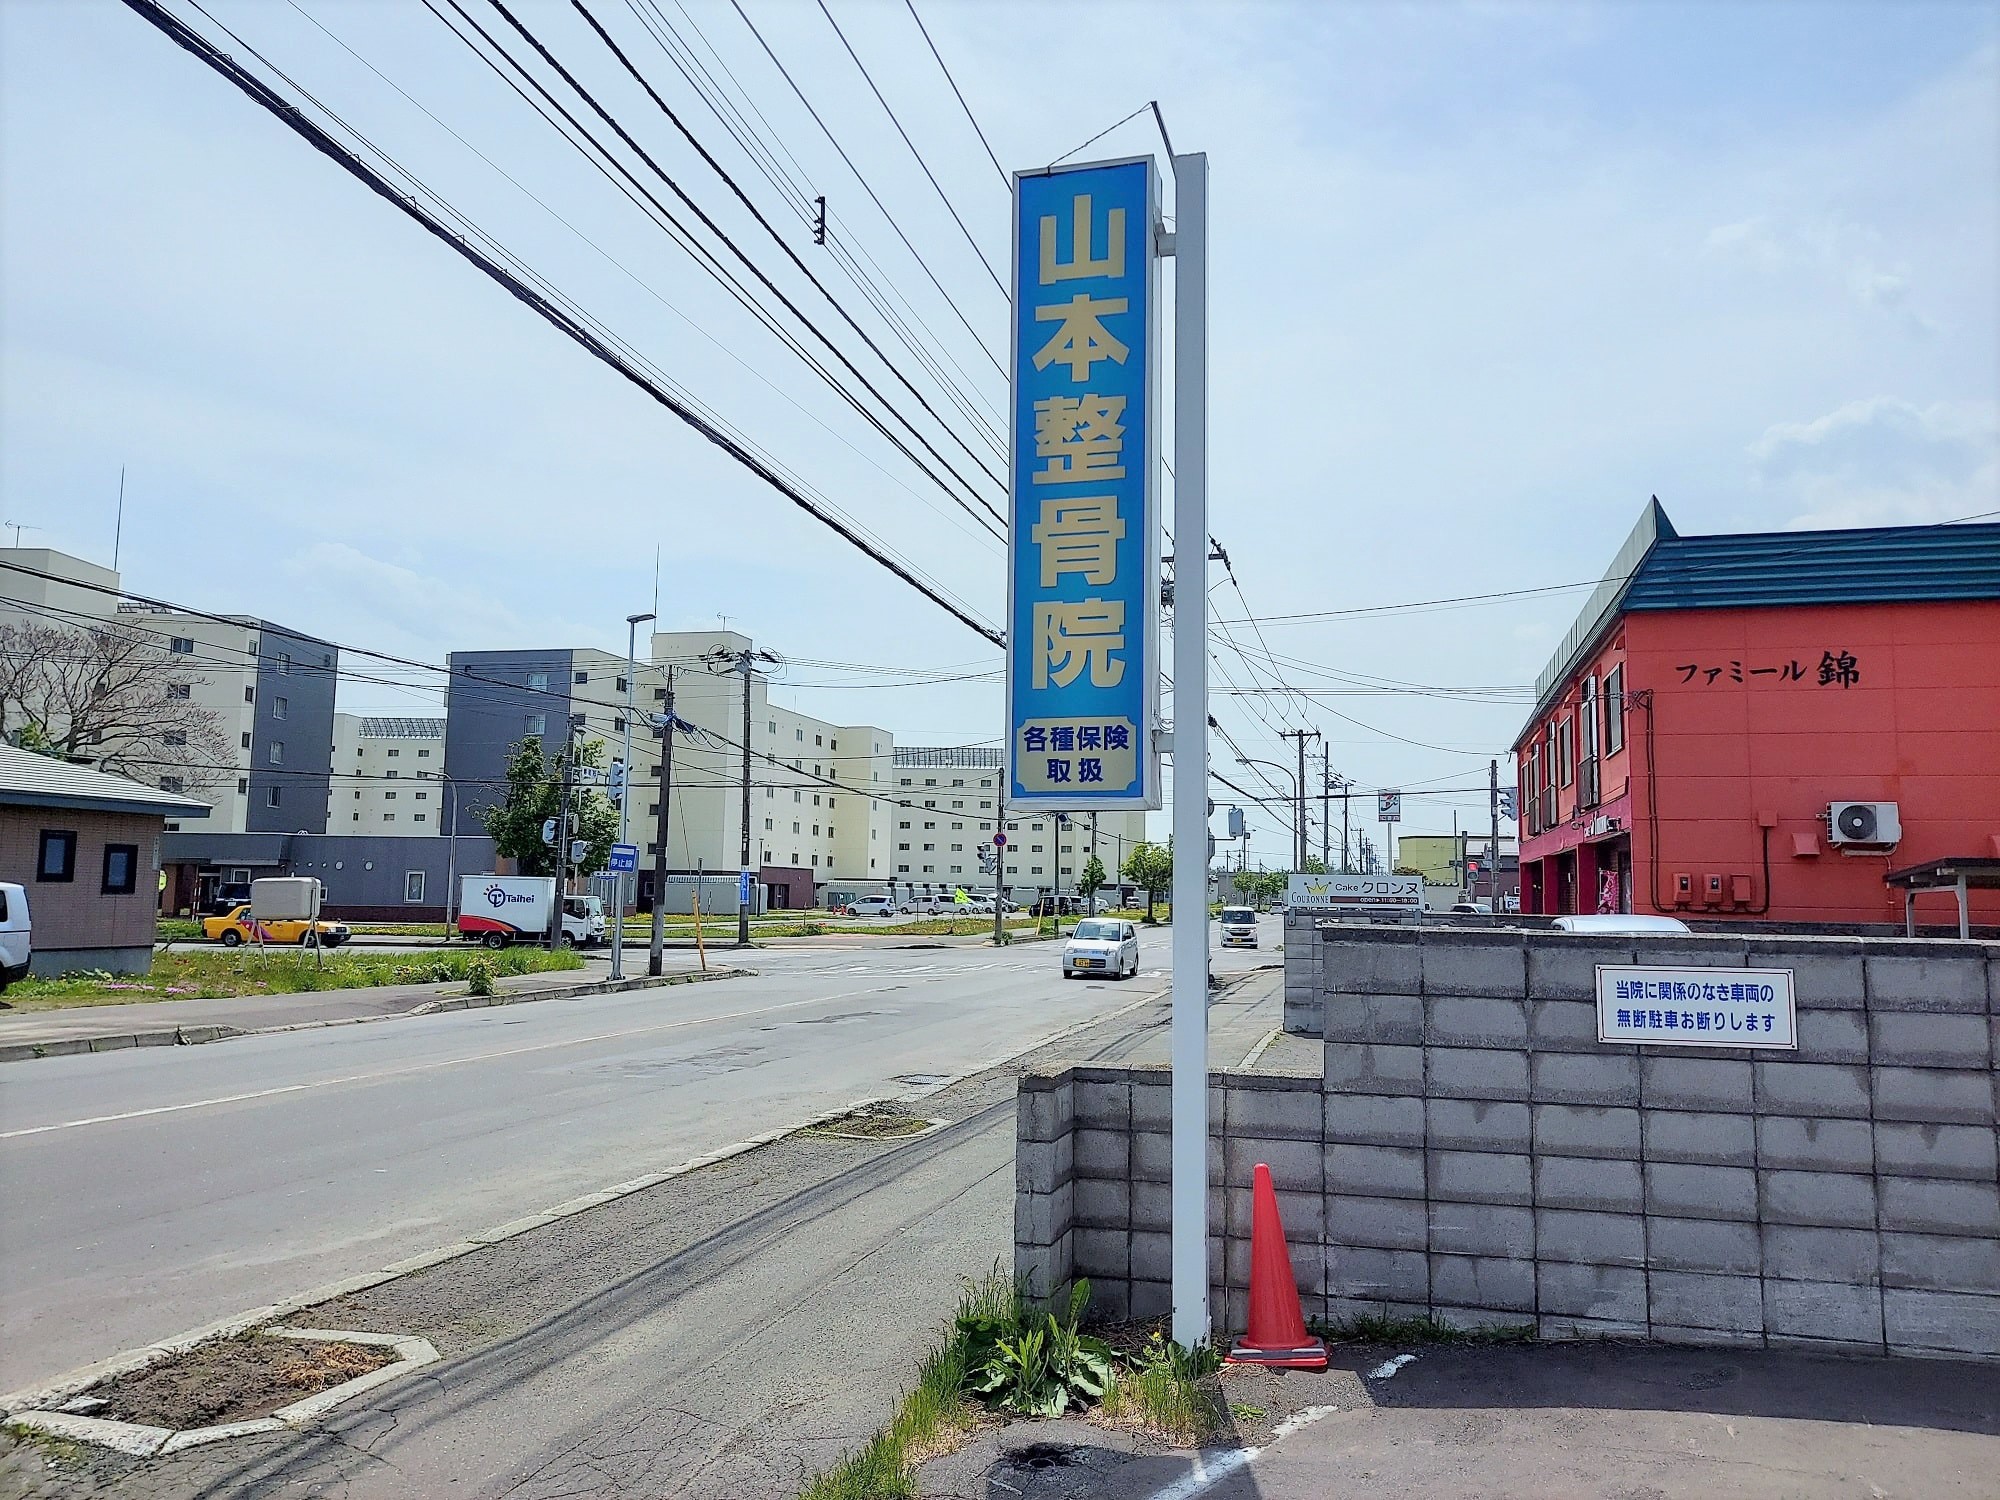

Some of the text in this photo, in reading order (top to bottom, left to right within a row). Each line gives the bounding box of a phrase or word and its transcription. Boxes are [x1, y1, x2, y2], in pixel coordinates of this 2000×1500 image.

[1032, 194, 1130, 689] 山本整骨院
[1675, 650, 1860, 689] ファミール 錦
[1023, 724, 1130, 752] 各種保険
[1047, 758, 1104, 784] 取扱
[506, 894, 535, 903] Taihei
[1335, 881, 1419, 894] Cake クロンヌ
[1616, 980, 1774, 1003] 当院に関係のなき車両の
[1617, 1008, 1775, 1032] 無断駐車お断りします
